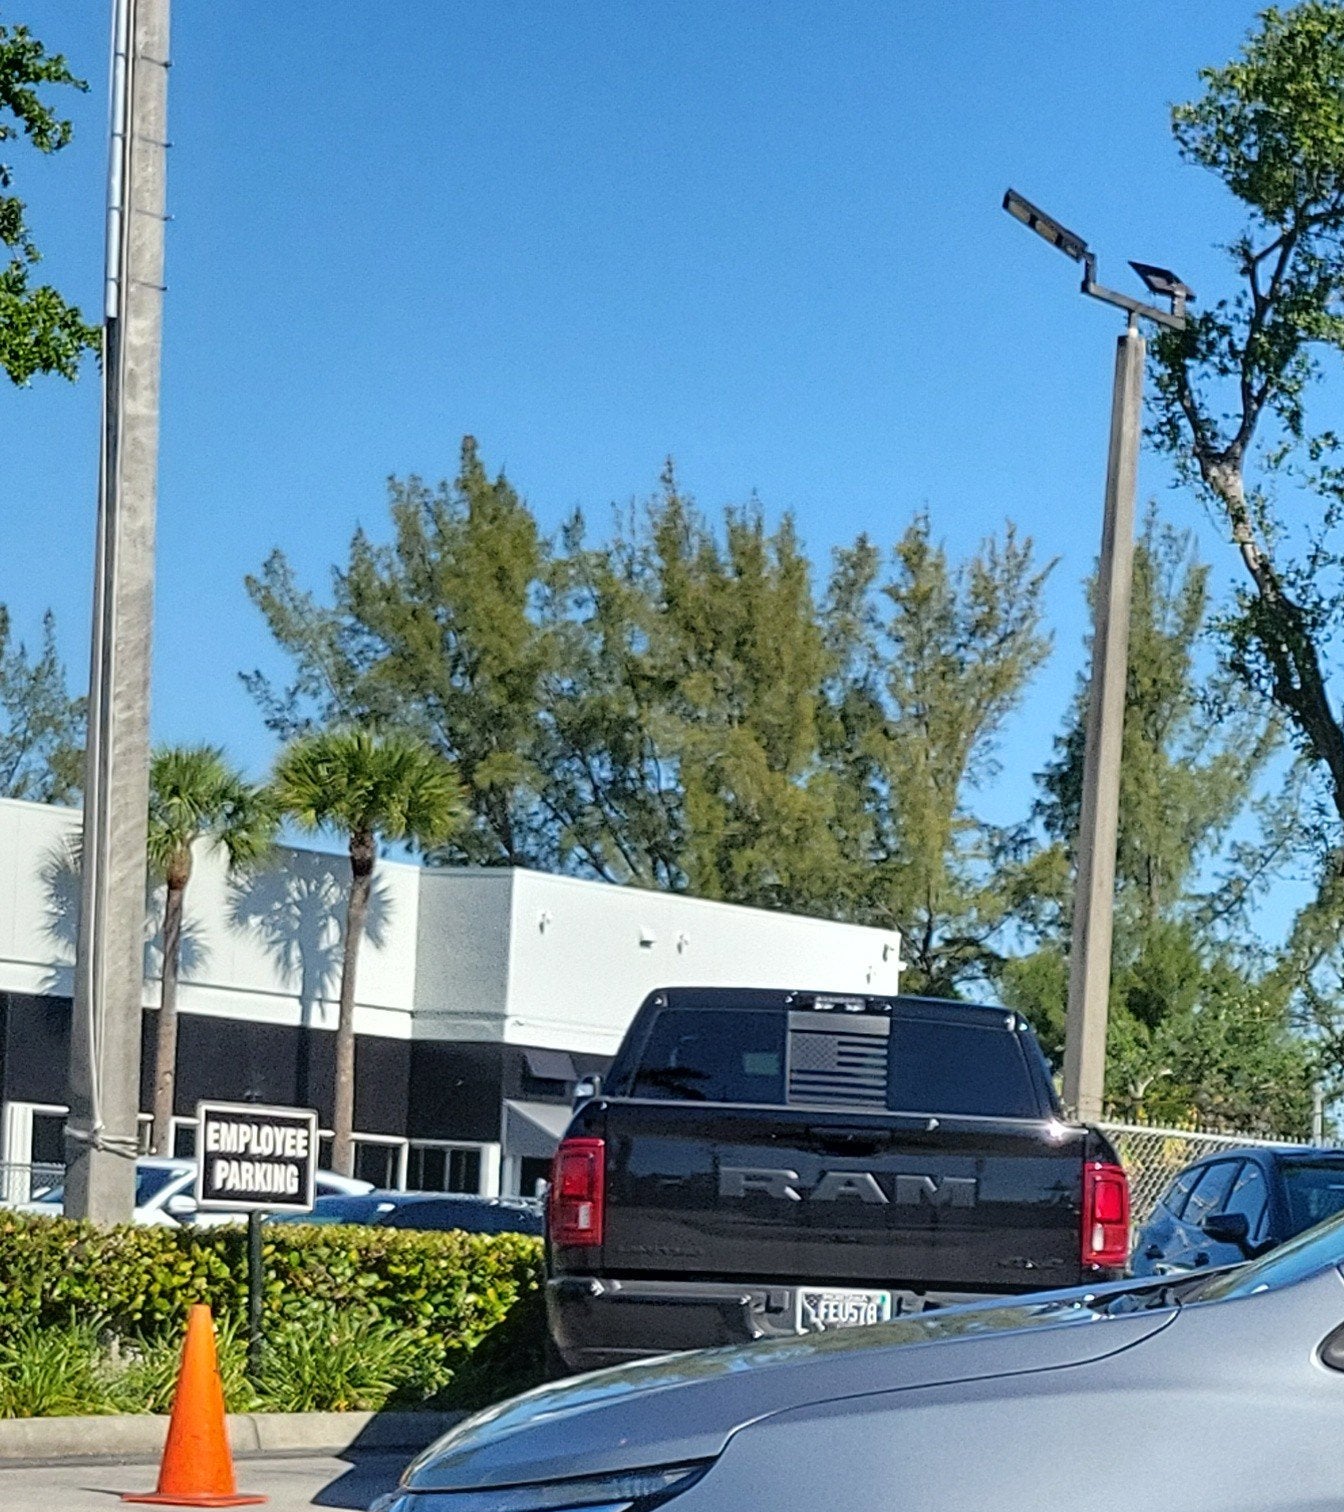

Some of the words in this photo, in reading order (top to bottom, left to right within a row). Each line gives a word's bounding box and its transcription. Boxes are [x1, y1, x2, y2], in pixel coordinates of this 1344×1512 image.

[206, 1121, 309, 1158] EMPLOYEE
[213, 1159, 299, 1195] PARKING
[719, 1166, 976, 1207] RAM
